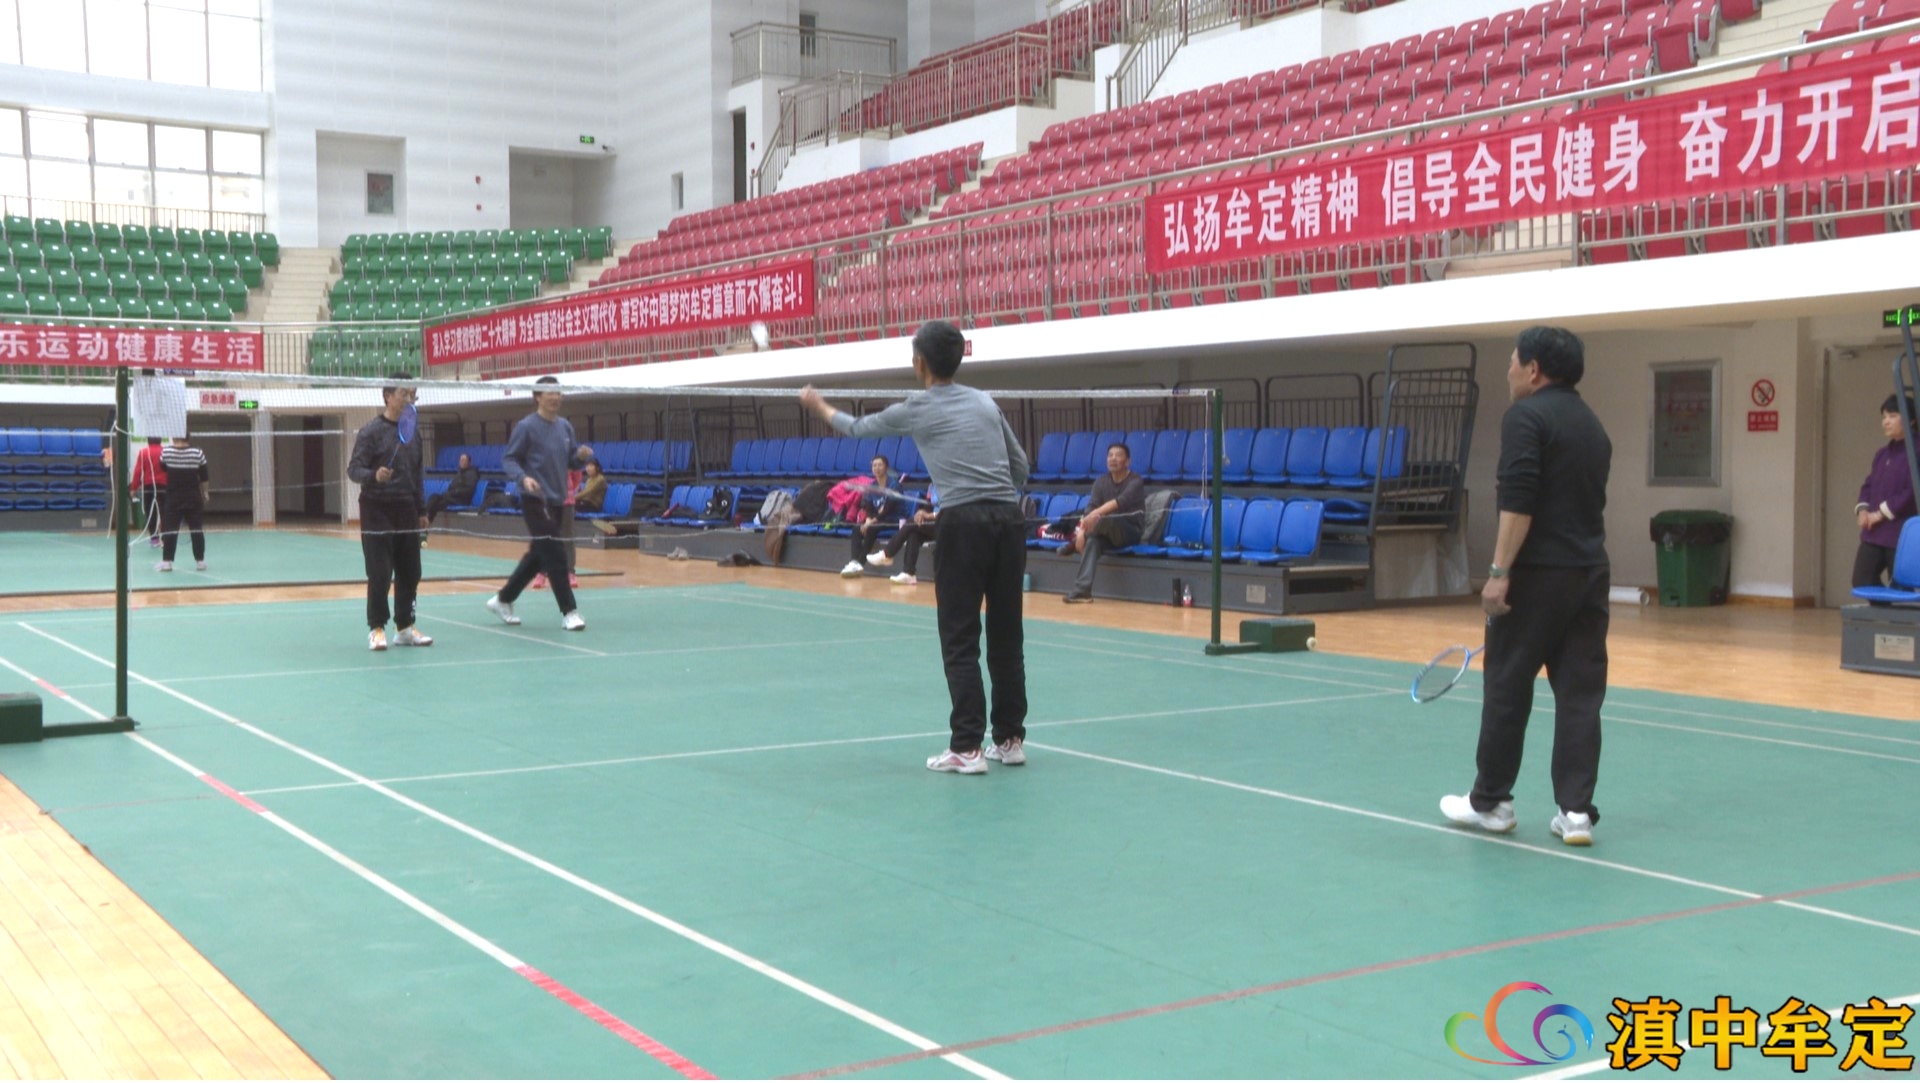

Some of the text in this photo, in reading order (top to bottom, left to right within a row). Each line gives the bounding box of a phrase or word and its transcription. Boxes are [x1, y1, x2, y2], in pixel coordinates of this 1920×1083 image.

[1163, 60, 1920, 257] 弘扬牟定精神 倡导全民健身 奋力开启
[519, 300, 617, 344] 为全面建设社会主义现代化
[0, 329, 257, 366] 乐运动健康生活
